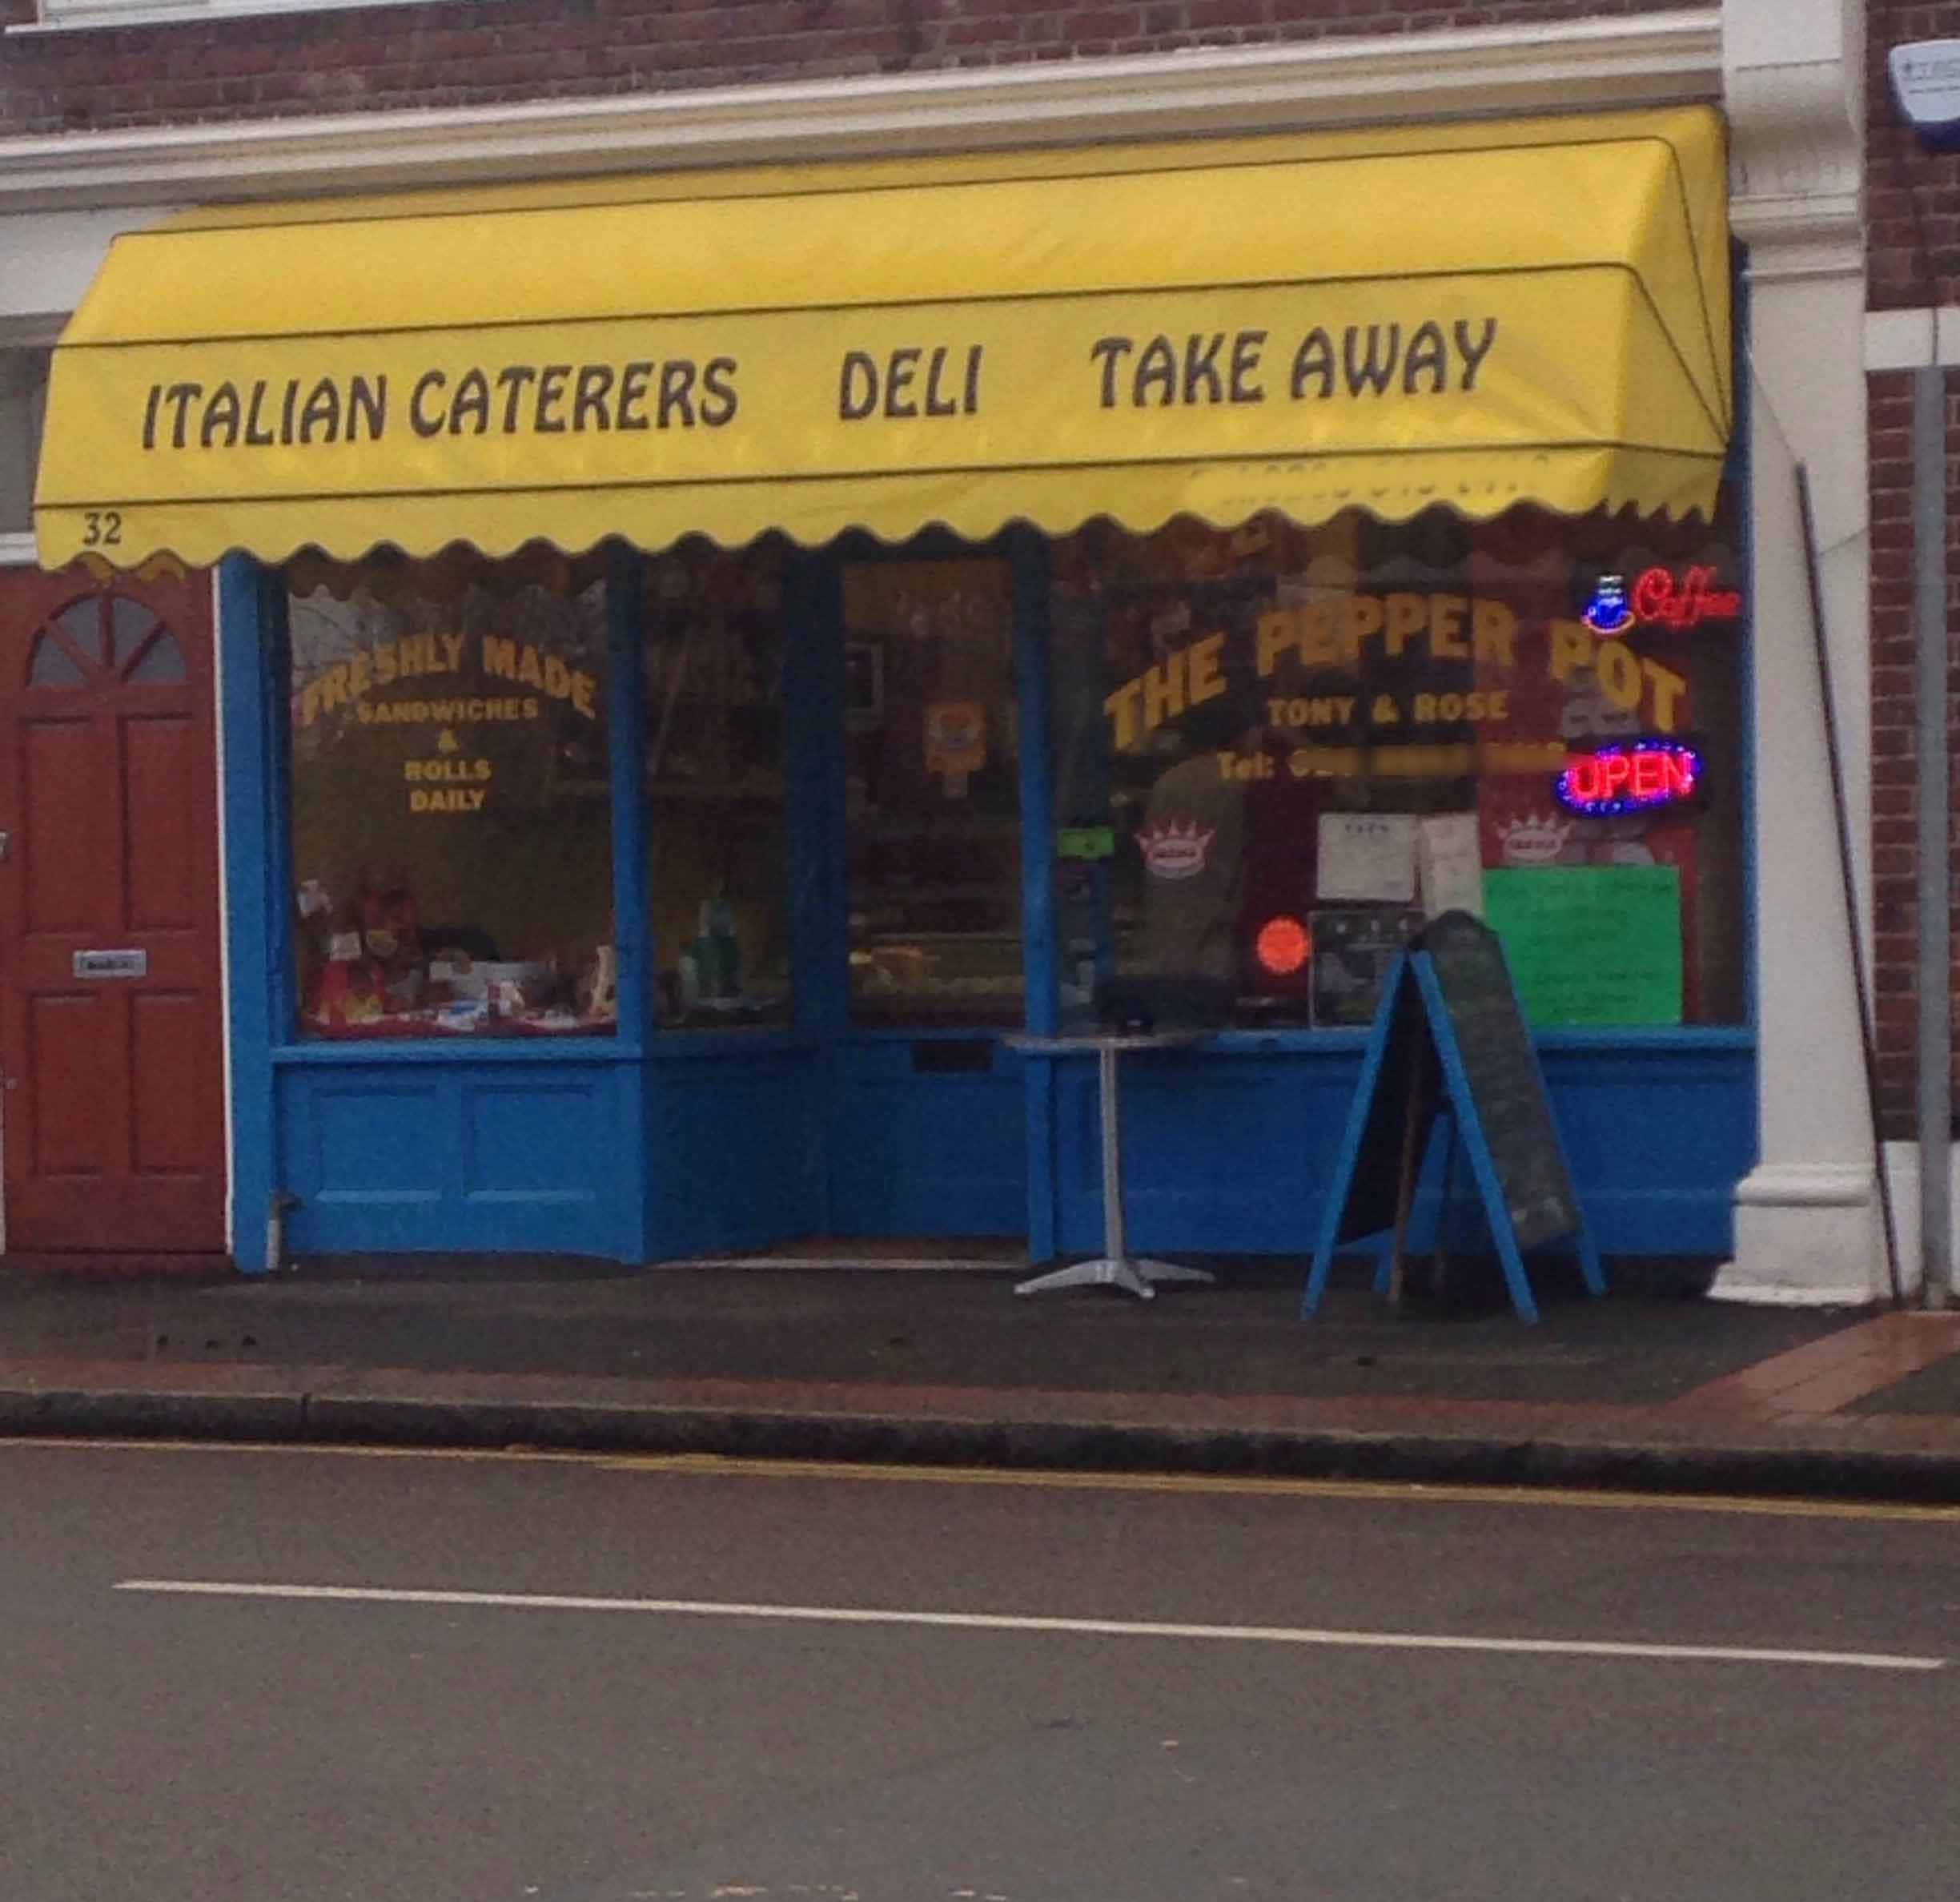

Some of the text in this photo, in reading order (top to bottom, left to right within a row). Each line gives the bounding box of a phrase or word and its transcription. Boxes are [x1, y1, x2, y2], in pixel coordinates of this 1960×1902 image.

[143, 318, 1497, 449] ITALIAN CATERERS DELI TAKE AWAY
[83, 513, 122, 545] 32
[301, 633, 596, 727] FRESHLY MADE
[1102, 593, 1687, 751] THE PEPPER POT
[358, 698, 538, 724] SANDWICHES
[1268, 690, 1509, 726] TONY & ROSE
[404, 759, 492, 782] ROLLS
[1568, 751, 1695, 799] OPEN
[410, 789, 486, 813] DAILY
